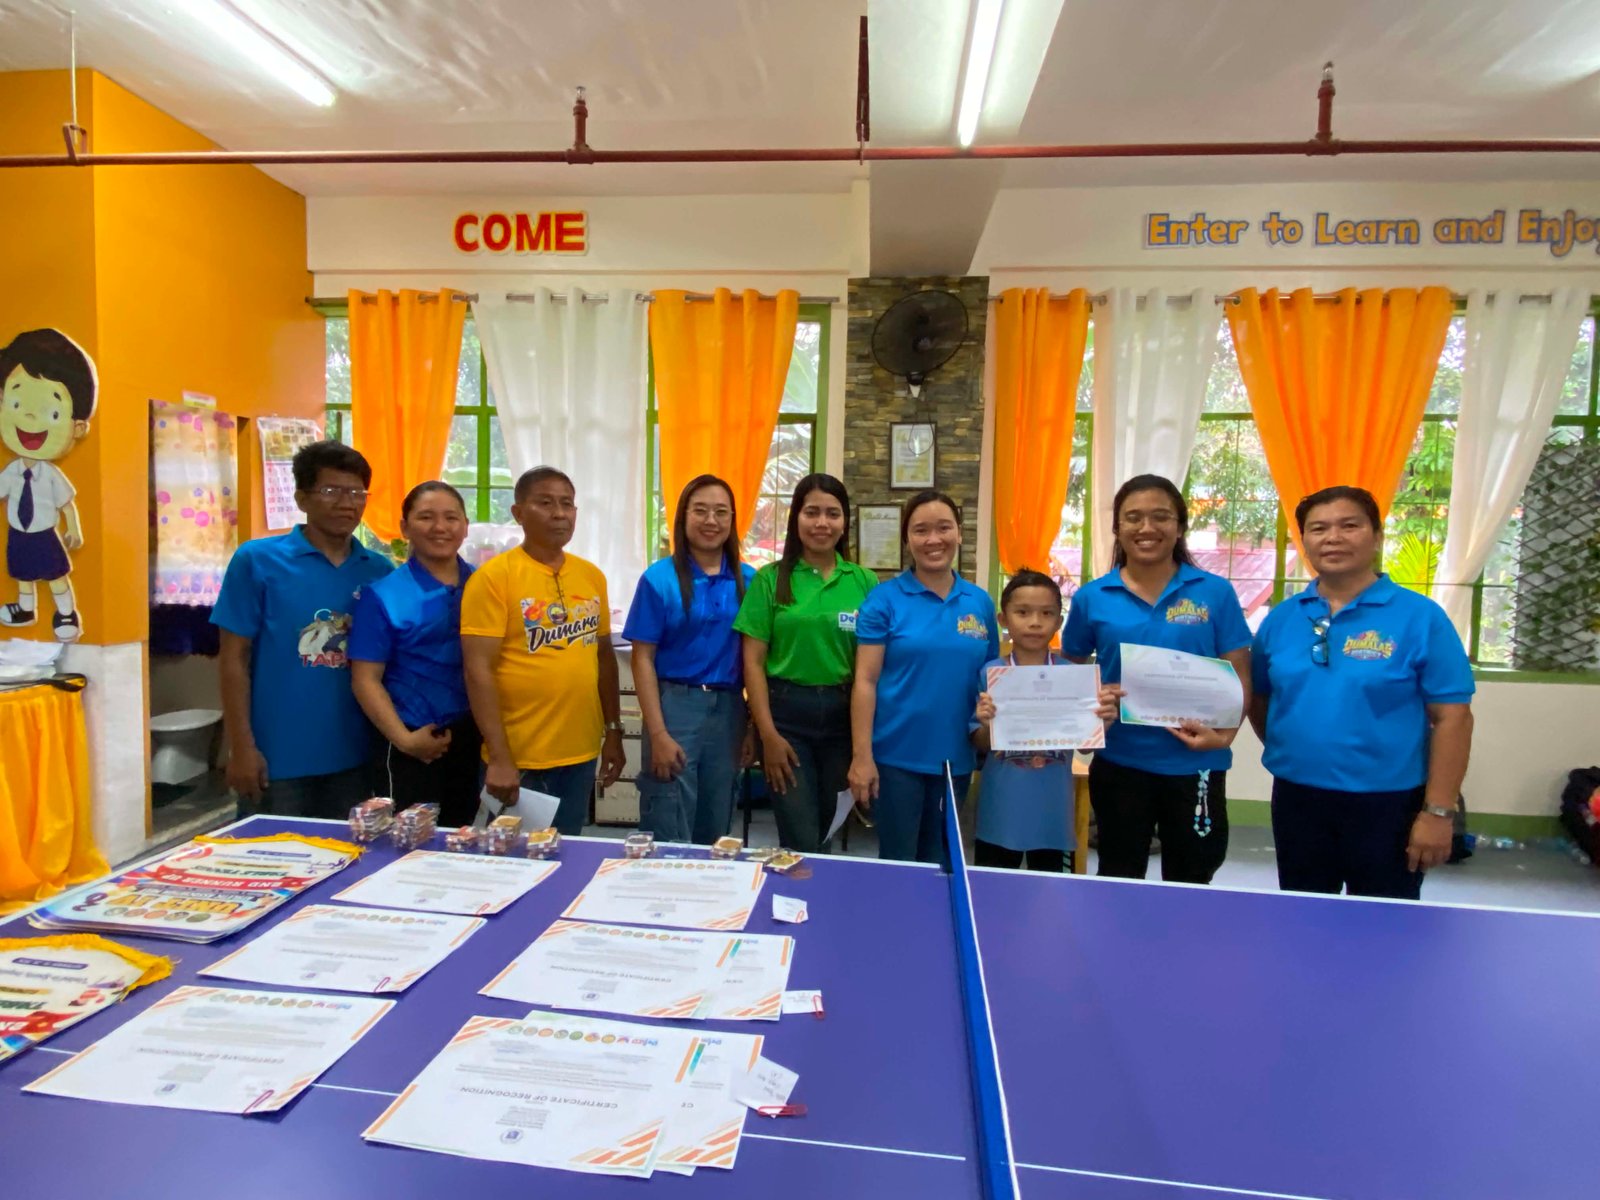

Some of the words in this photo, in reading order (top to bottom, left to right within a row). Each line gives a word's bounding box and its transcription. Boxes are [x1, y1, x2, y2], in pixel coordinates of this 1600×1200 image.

[454, 212, 585, 252] COME
[1148, 213, 1250, 246] Enter
[1262, 212, 1303, 245] to
[1315, 212, 1420, 245] Learn
[1433, 210, 1506, 244] and
[301, 653, 352, 667] TAP
[459, 1086, 532, 1101] RECOGNITION
[532, 1094, 548, 1102] OF
[549, 1095, 619, 1109] CERTIFICATE
